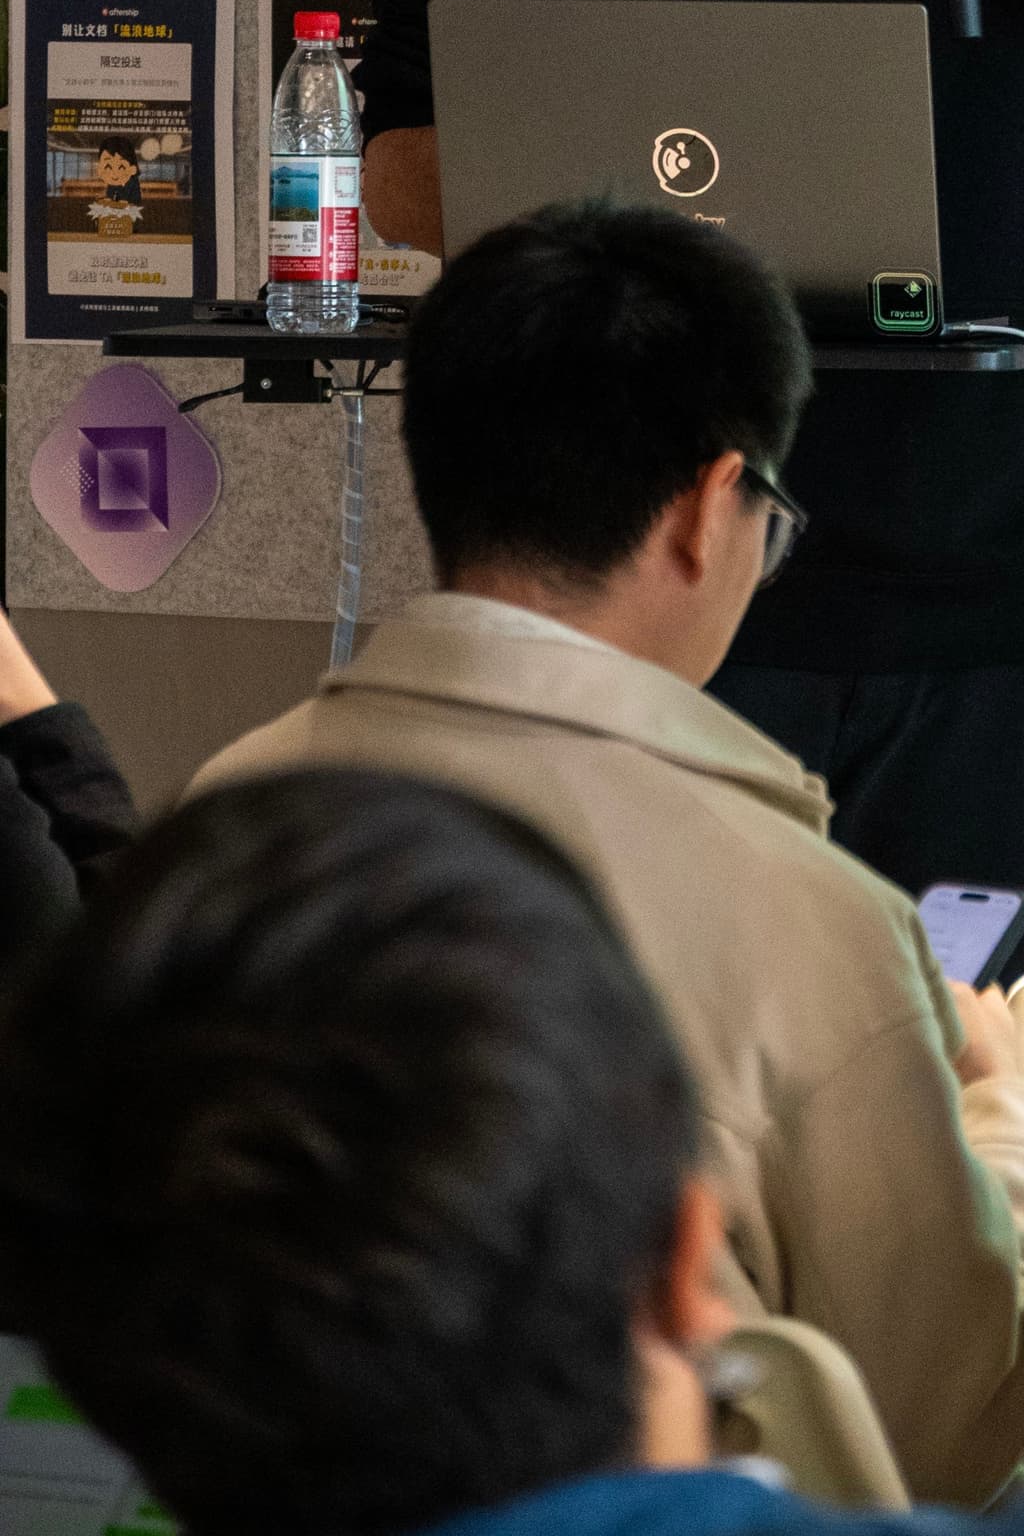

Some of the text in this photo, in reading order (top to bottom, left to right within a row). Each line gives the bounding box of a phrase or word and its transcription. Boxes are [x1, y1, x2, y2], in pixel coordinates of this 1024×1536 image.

[100, 55, 142, 69] 隔空投送
[890, 310, 925, 320] raycast
